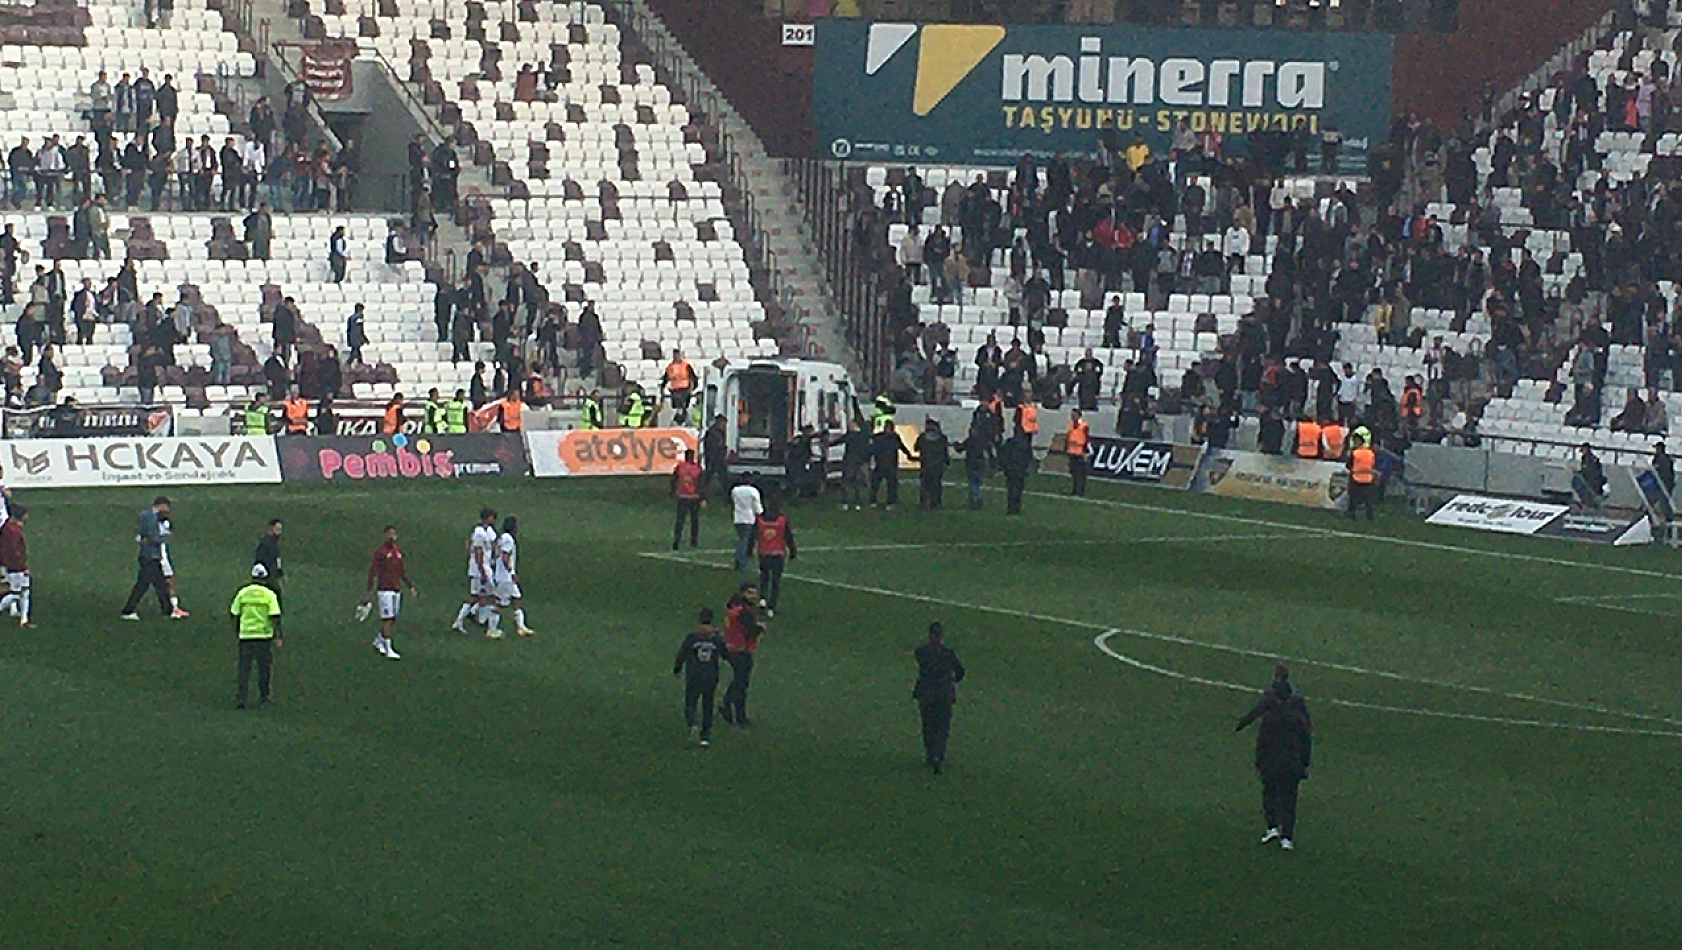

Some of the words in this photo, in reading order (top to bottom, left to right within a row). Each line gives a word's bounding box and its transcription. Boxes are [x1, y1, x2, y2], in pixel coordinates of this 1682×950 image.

[785, 28, 812, 41] 201
[1002, 36, 1325, 108] minerra
[65, 441, 268, 471] HCKAYA
[319, 439, 454, 479] Pembis
[1094, 442, 1171, 475] LUXEM
